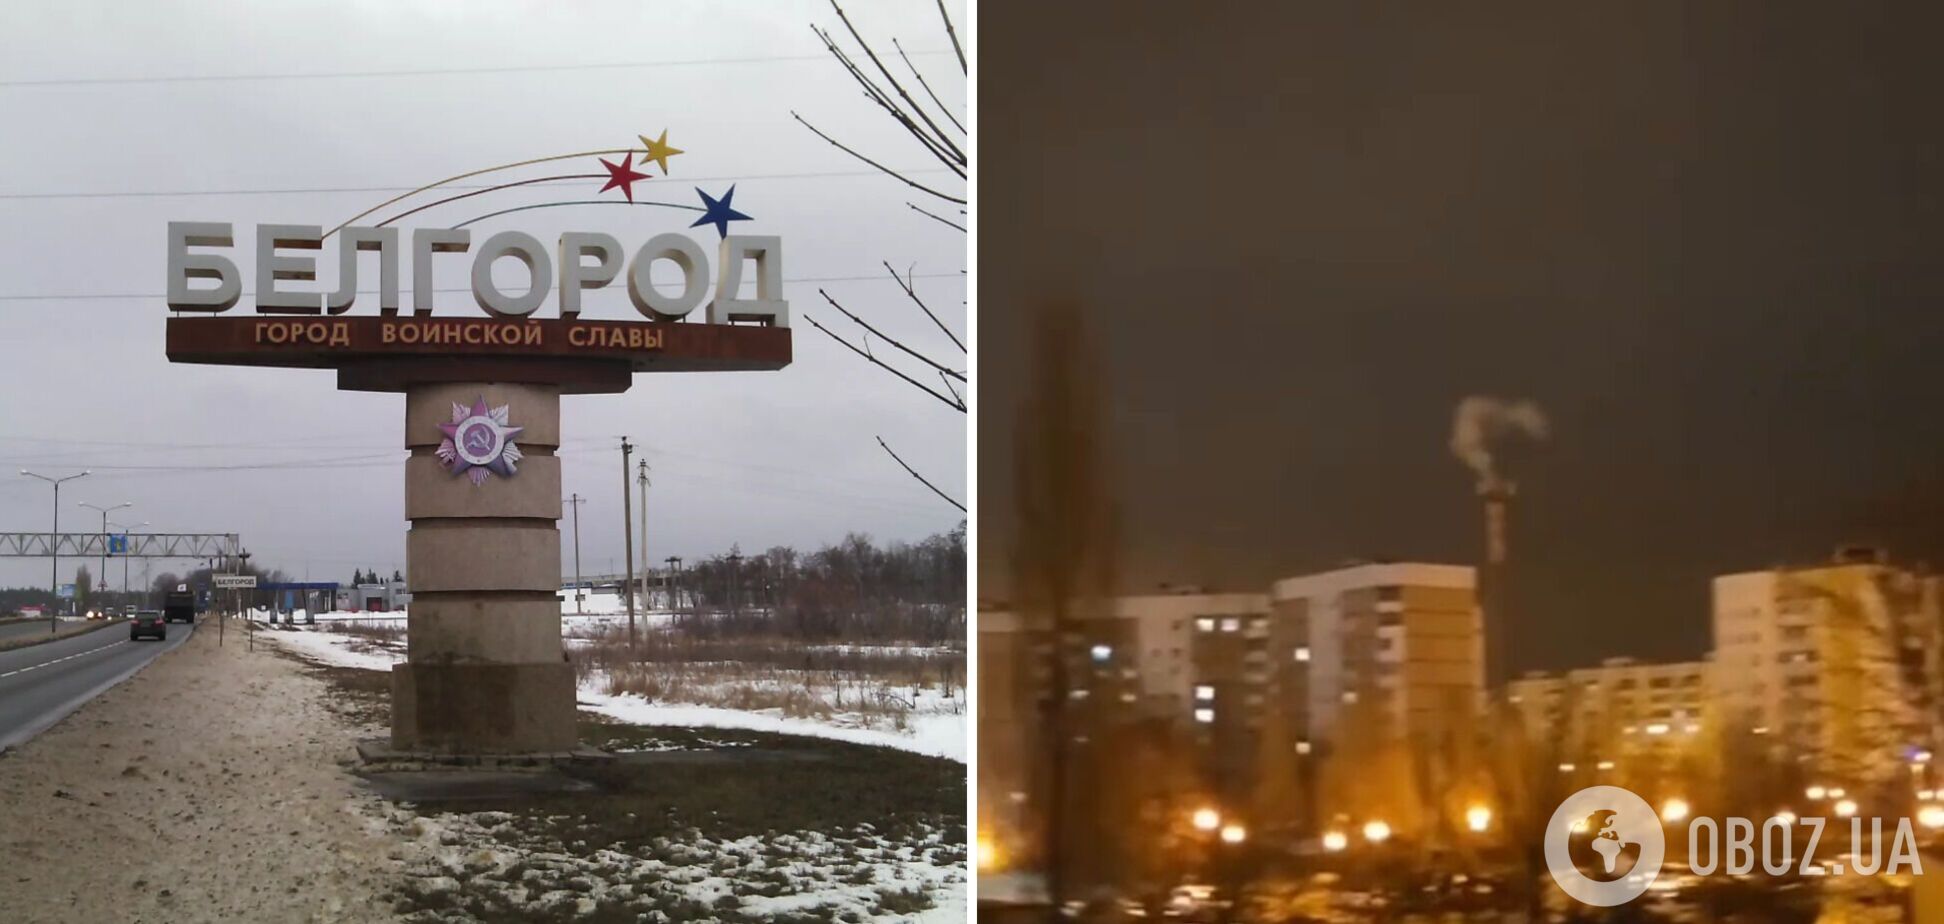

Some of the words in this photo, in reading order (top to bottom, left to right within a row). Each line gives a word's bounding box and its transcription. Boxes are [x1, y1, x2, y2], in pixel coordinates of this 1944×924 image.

[167, 222, 789, 327] БЕЛГОРОД
[254, 322, 350, 347] ГОРОД
[381, 319, 543, 346] ВОИНСКОЙ
[568, 325, 664, 349] СЛАВЫ
